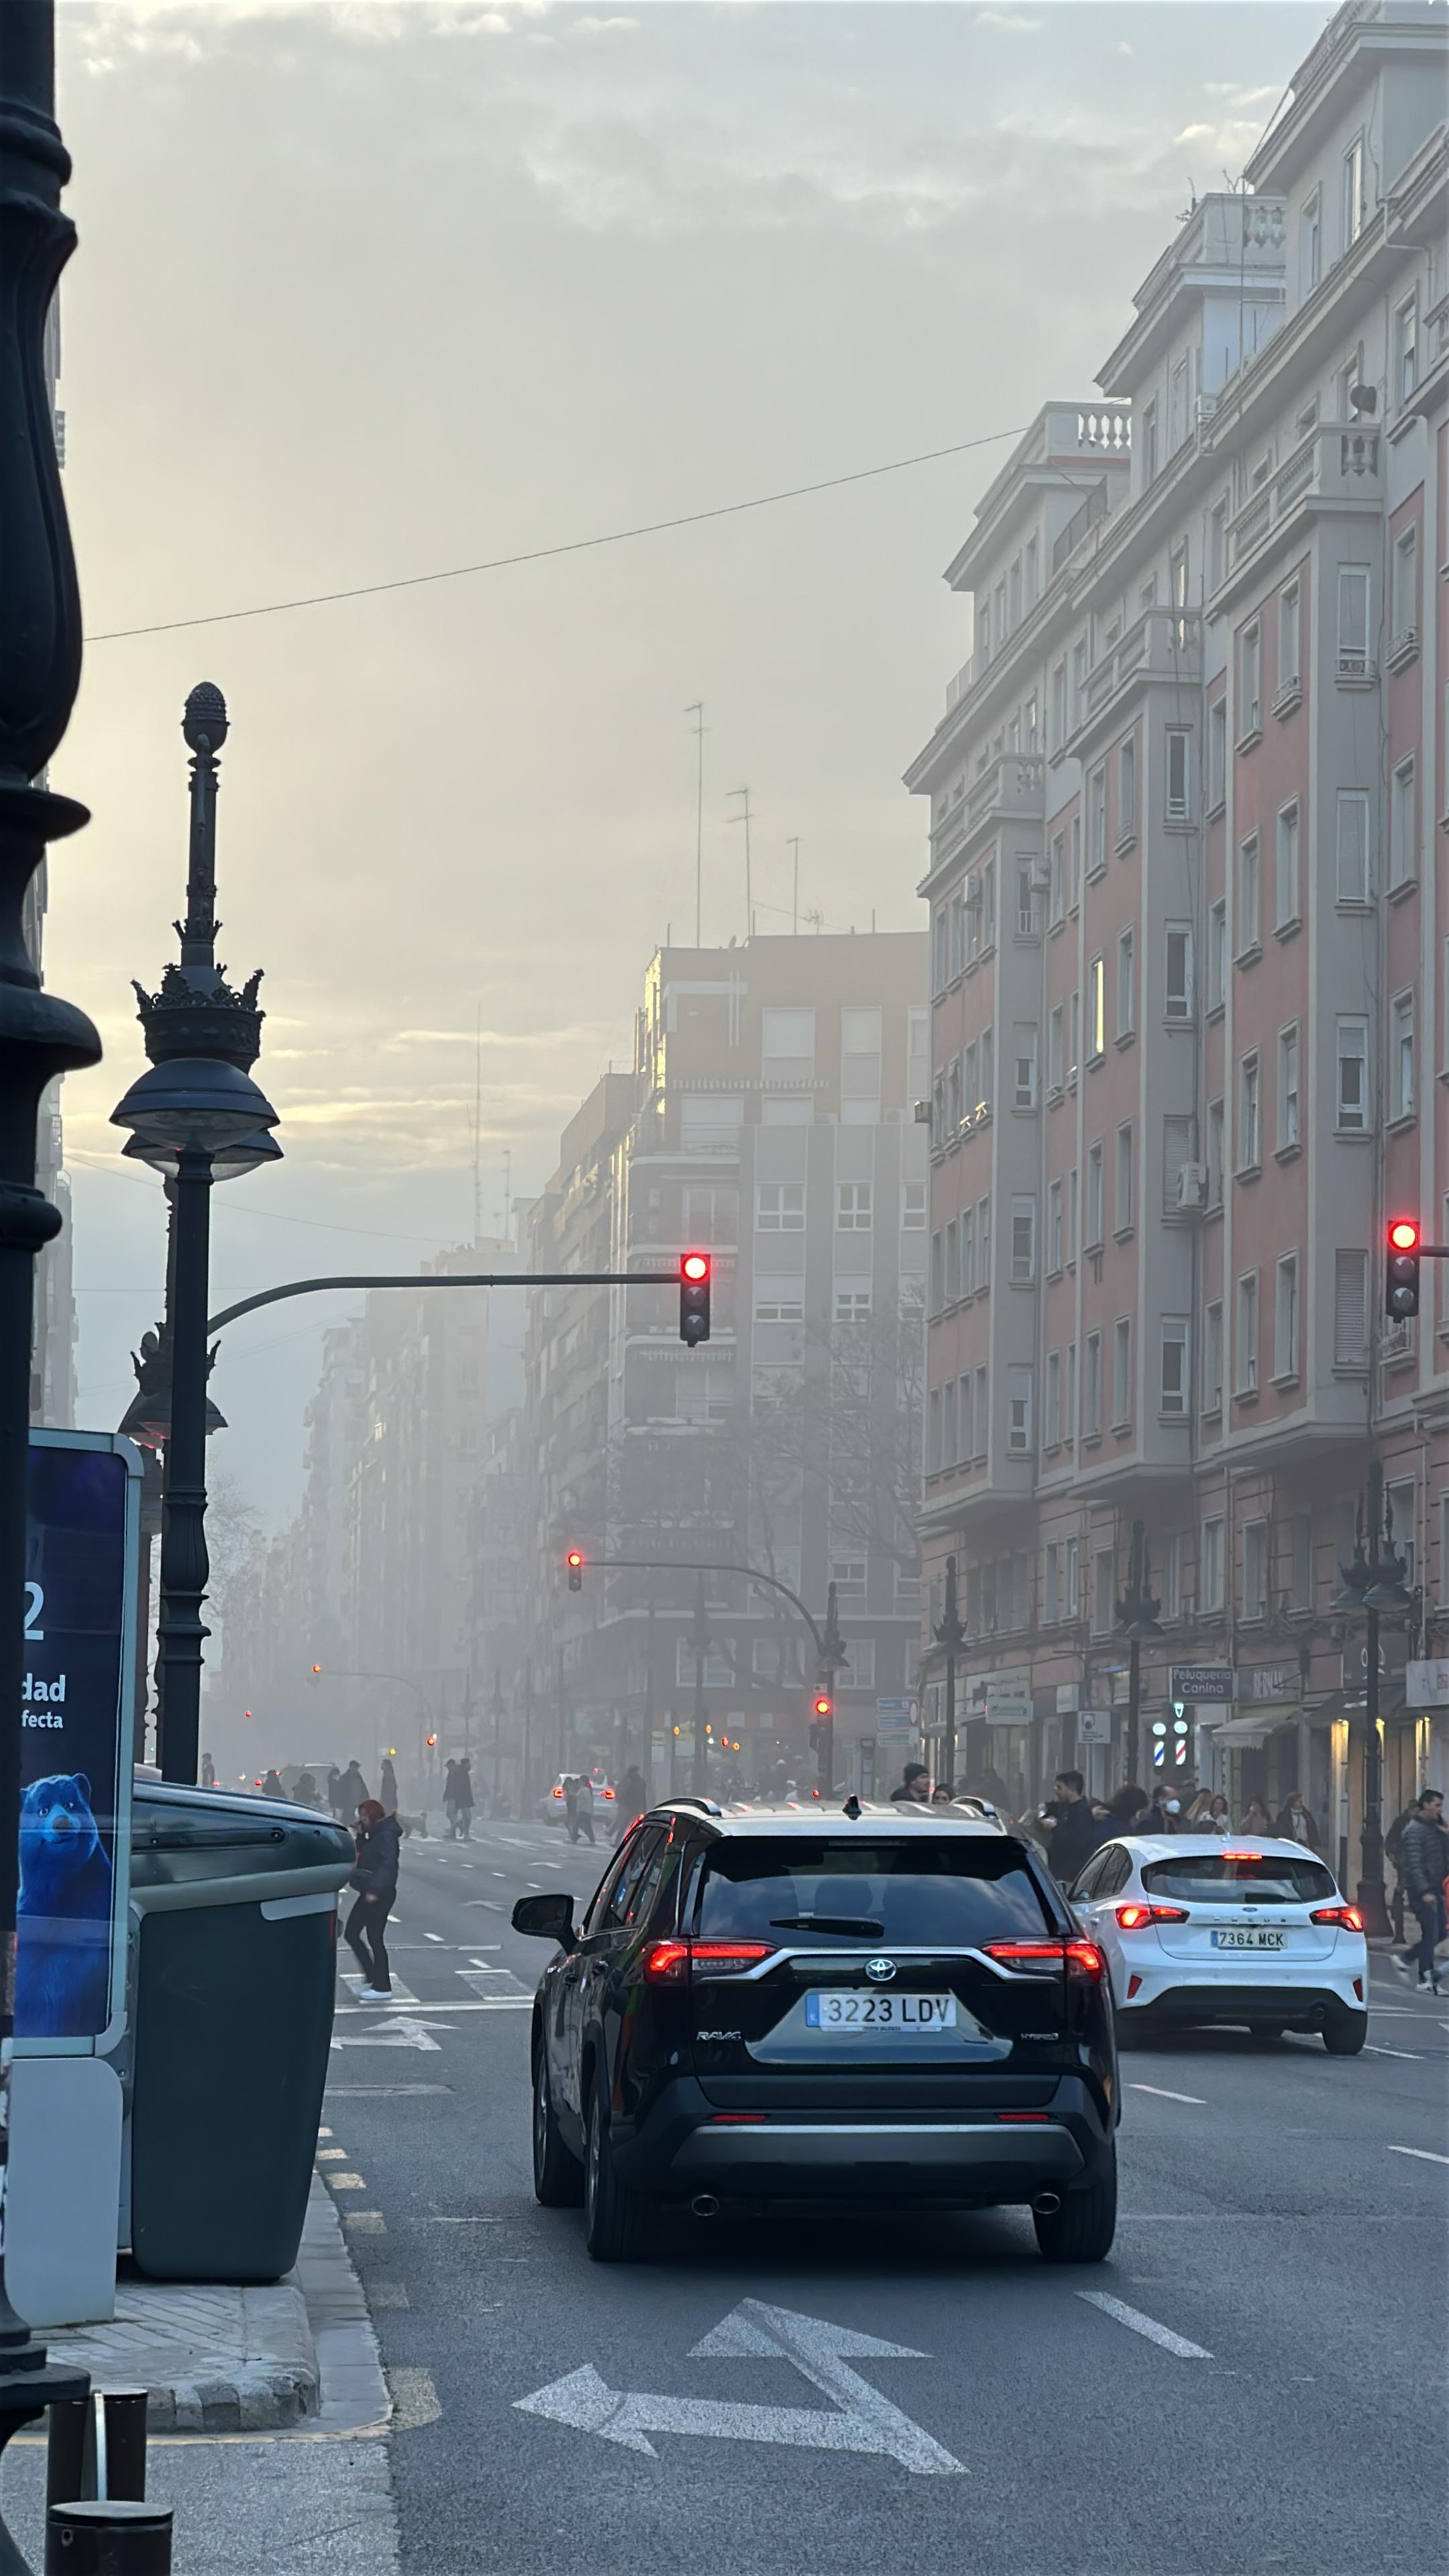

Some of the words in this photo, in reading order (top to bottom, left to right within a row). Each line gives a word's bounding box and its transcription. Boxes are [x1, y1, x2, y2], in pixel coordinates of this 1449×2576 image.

[1181, 1682, 1224, 1694] Canina
[21, 1709, 64, 1729] fecta
[1220, 1932, 1254, 1945] 7364
[1258, 1933, 1284, 1946] MCK
[828, 1998, 893, 2023] 3223
[902, 1998, 949, 2023] LDV
[696, 2031, 741, 2040] RAV4
